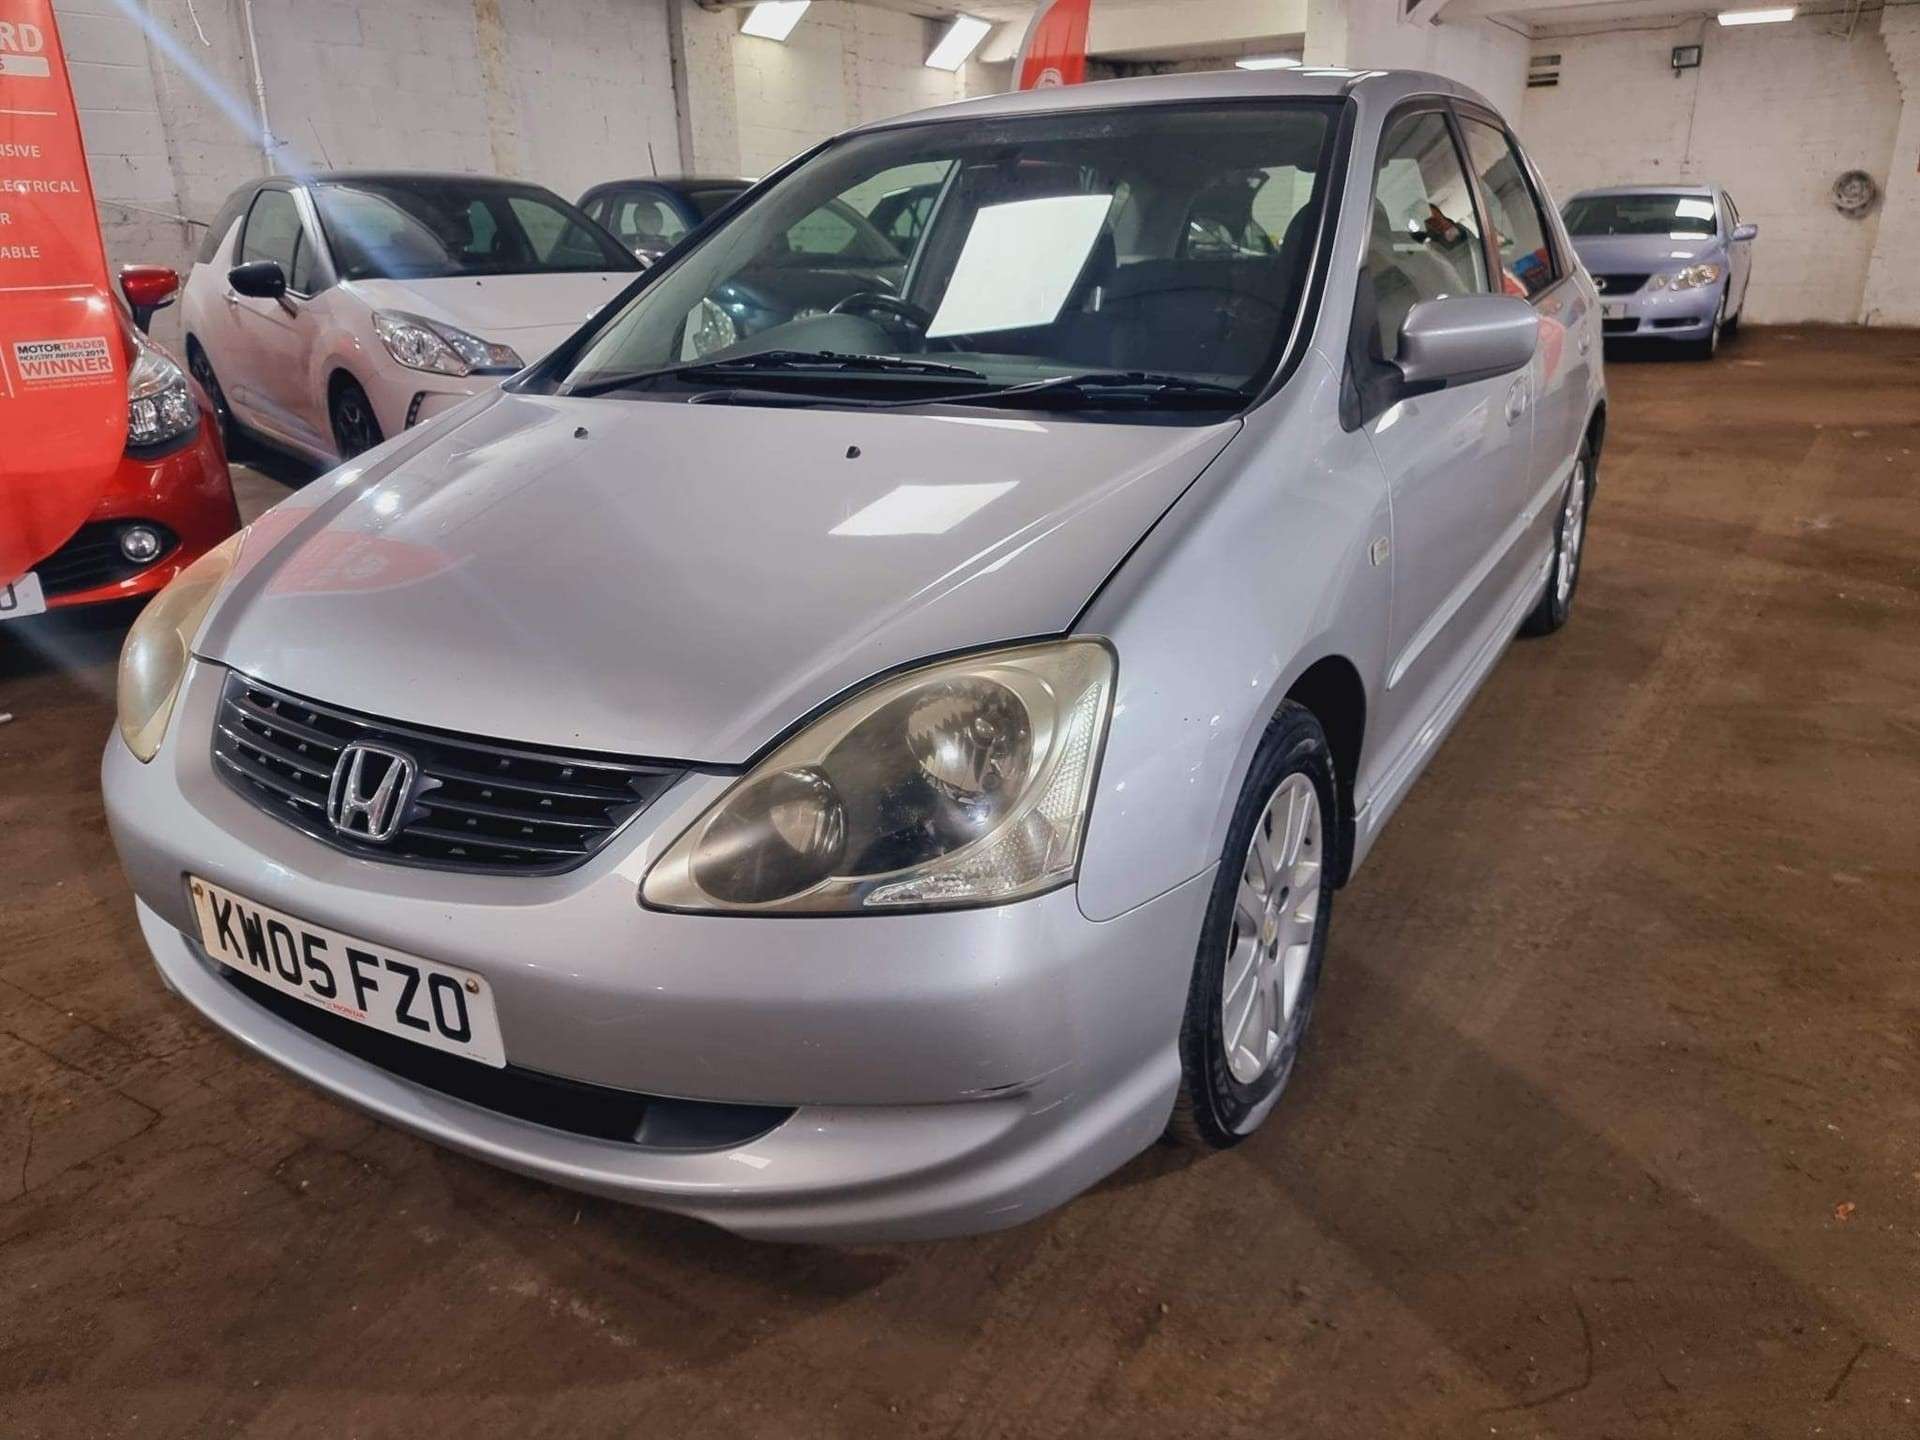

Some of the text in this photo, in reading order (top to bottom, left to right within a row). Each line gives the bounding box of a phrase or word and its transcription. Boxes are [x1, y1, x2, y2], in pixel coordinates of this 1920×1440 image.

[21, 357, 111, 376] WINNER
[209, 891, 471, 1043] KW05 FZO
